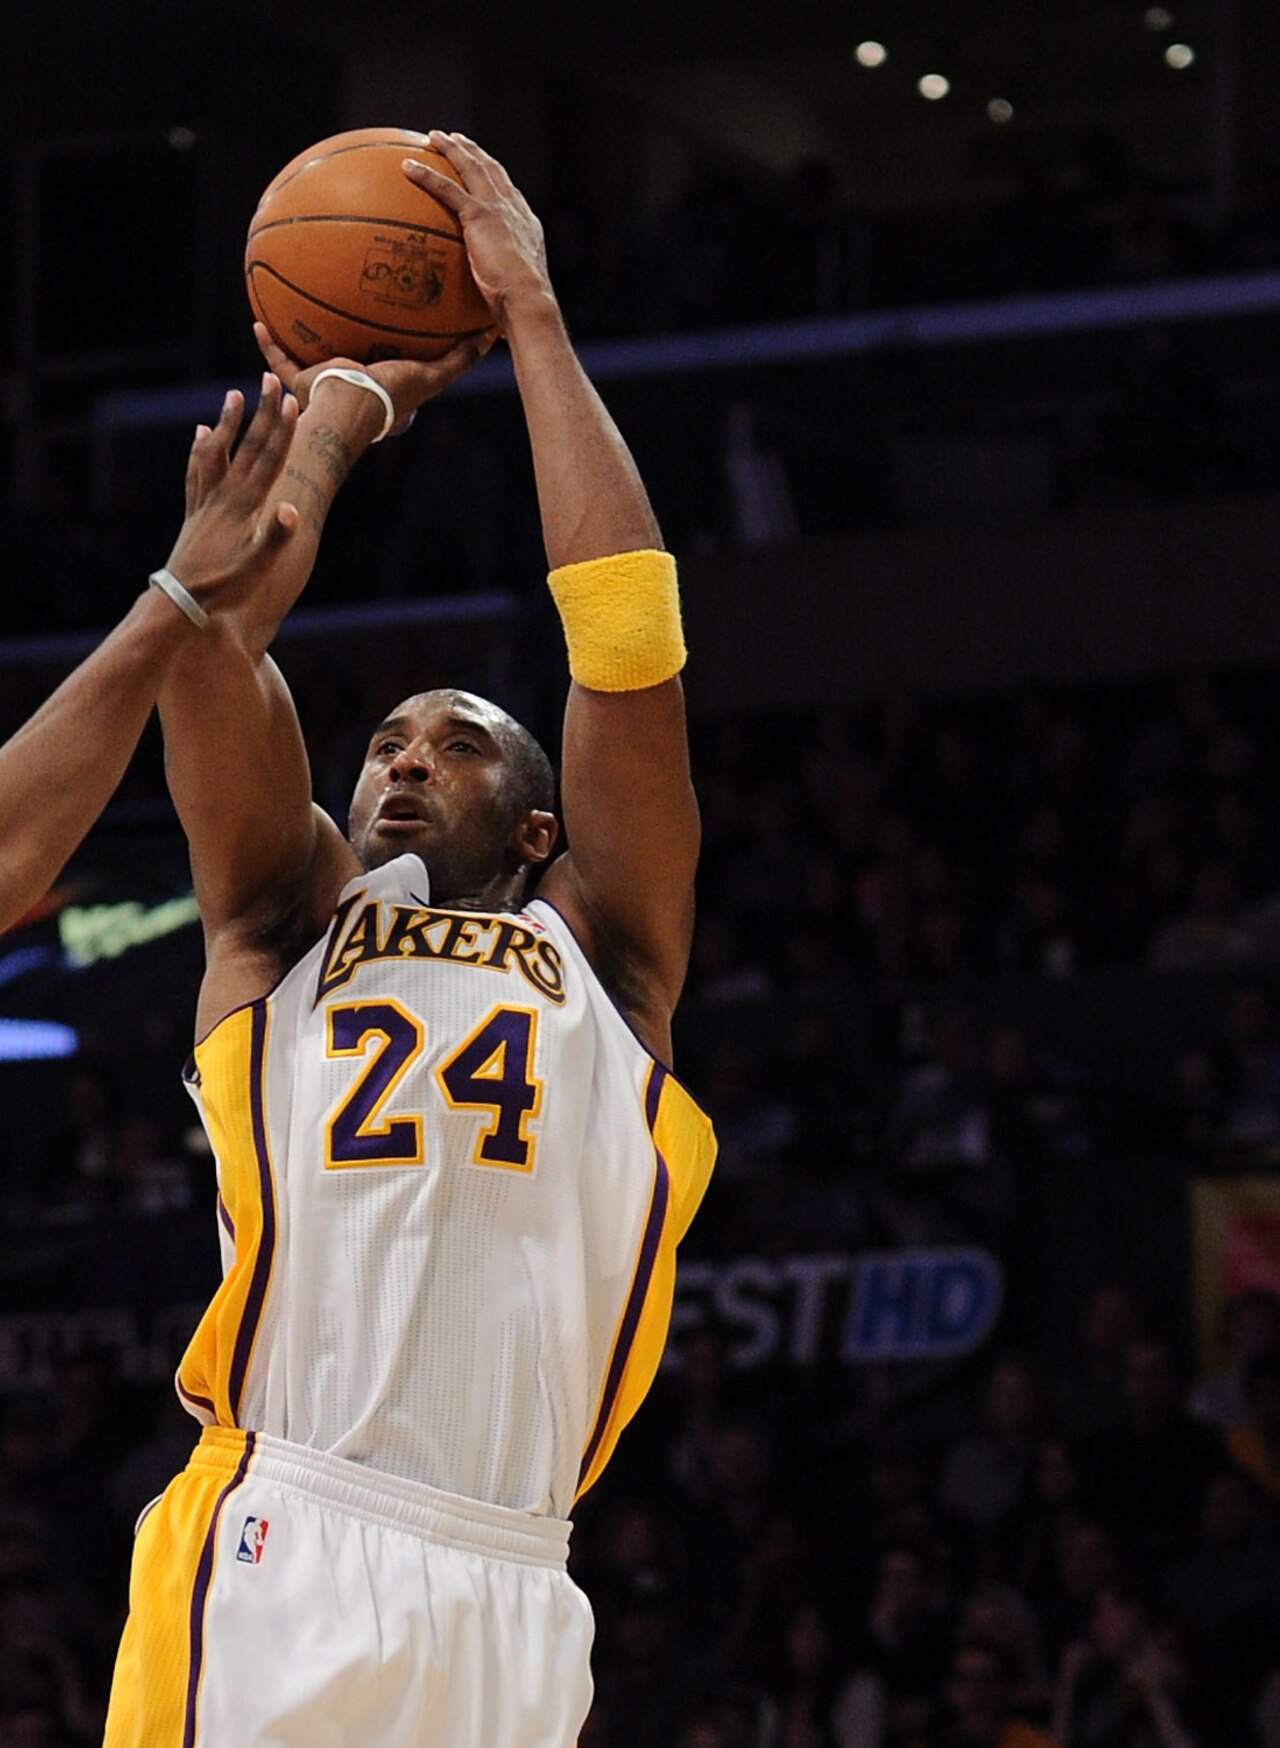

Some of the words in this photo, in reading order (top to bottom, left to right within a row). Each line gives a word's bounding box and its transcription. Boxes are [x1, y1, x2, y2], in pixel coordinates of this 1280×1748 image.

[312, 887, 566, 1007] LAKERS
[324, 997, 546, 1174] 24
[852, 1259, 990, 1352] HD
